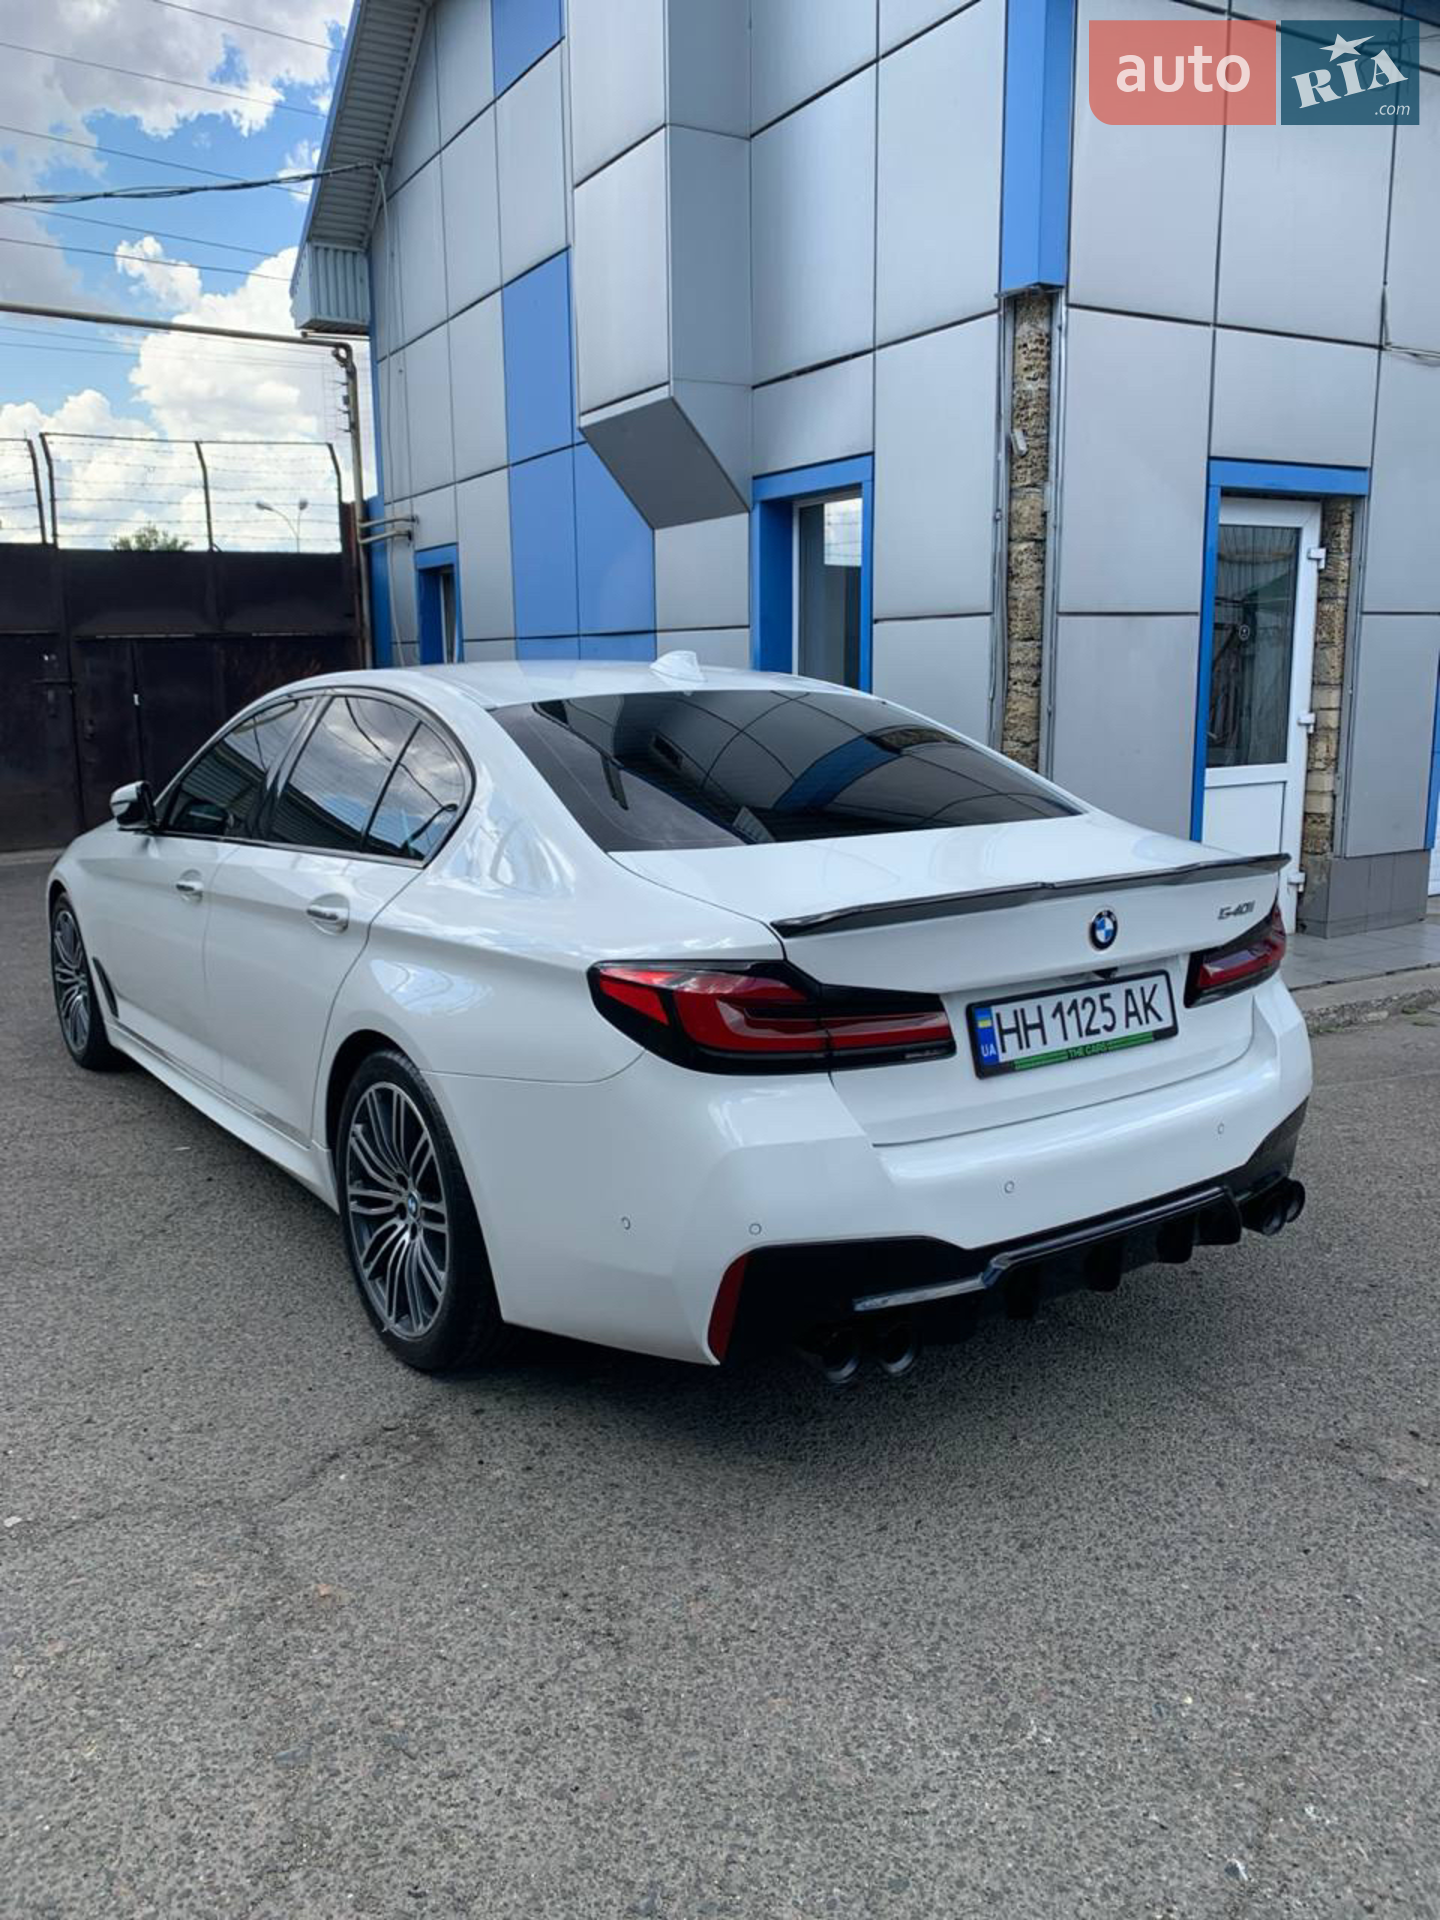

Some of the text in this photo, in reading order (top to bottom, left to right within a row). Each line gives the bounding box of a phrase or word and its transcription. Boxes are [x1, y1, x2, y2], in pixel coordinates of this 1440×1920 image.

[995, 983, 1164, 1054] HH 1125 AK
[981, 1045, 997, 1058] UA
